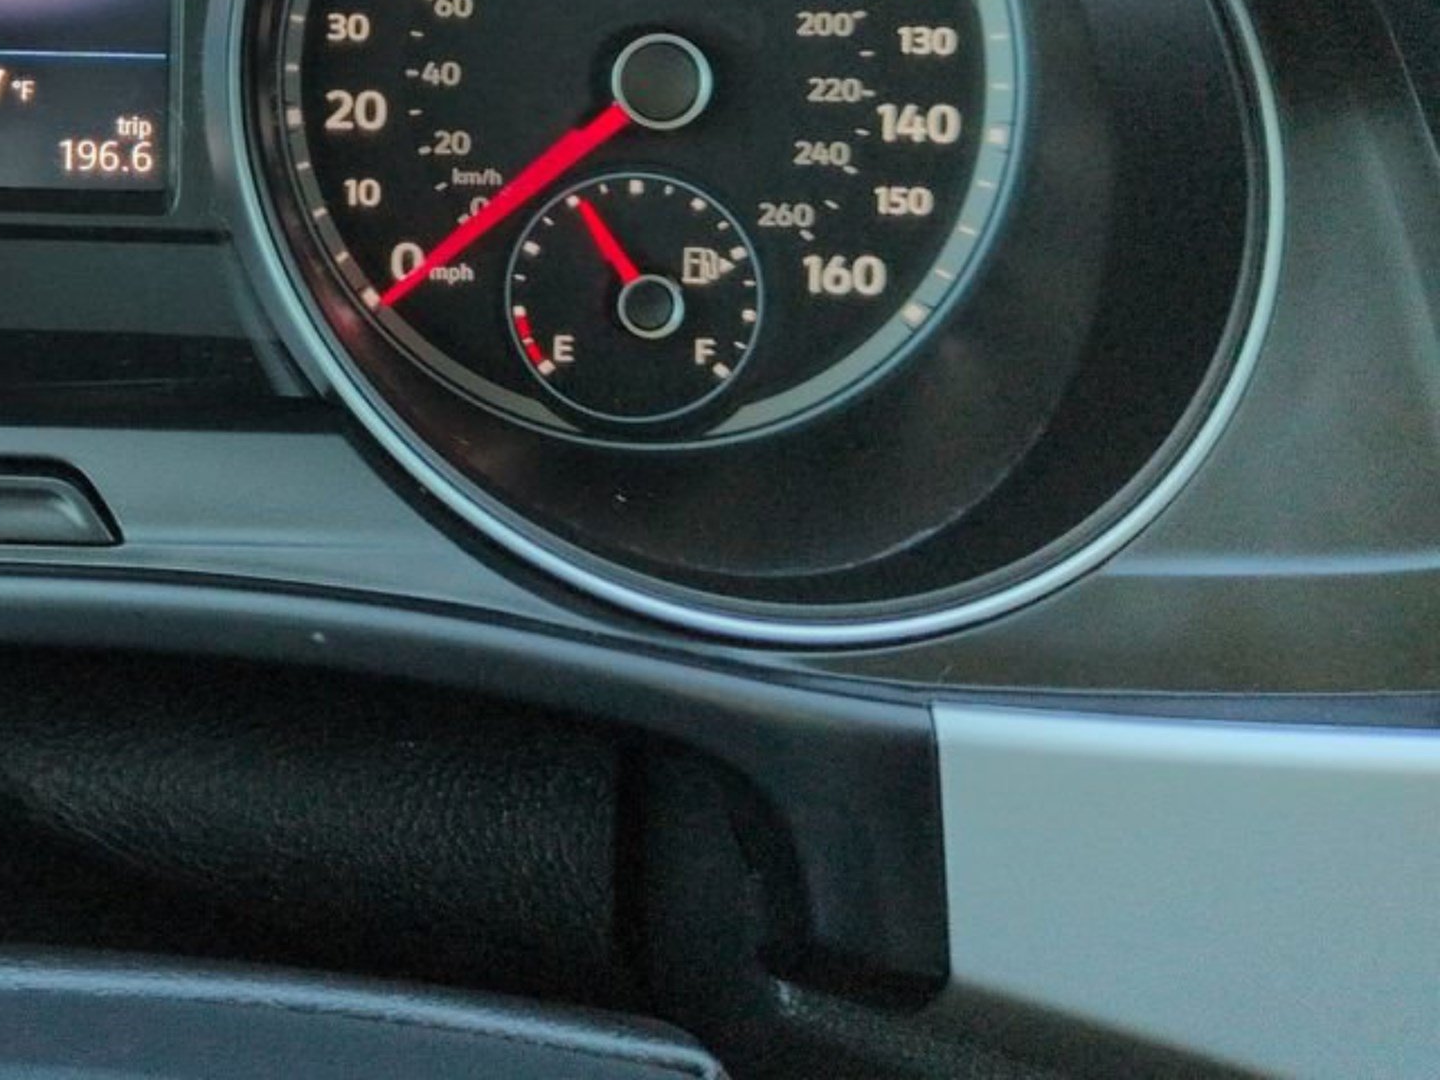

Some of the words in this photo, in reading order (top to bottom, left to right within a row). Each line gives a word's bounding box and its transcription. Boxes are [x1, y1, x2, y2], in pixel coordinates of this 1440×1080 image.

[326, 12, 371, 43] 30
[795, 11, 854, 37] 200
[897, 26, 958, 56] 130
[421, 62, 462, 86] 40
[807, 77, 862, 103] 220
[324, 90, 388, 131] 20
[876, 103, 961, 145] 140
[117, 116, 152, 140] trip
[59, 140, 153, 172] 196.6
[433, 131, 471, 156] 20
[792, 141, 852, 166] 240
[452, 167, 503, 186] km/h
[343, 179, 381, 207] 10
[874, 186, 935, 216] 150
[758, 203, 816, 228] 260
[391, 242, 427, 280] 0
[429, 263, 476, 284] mph
[802, 255, 888, 296] 160
[553, 335, 575, 363] E
[694, 338, 718, 366] F
